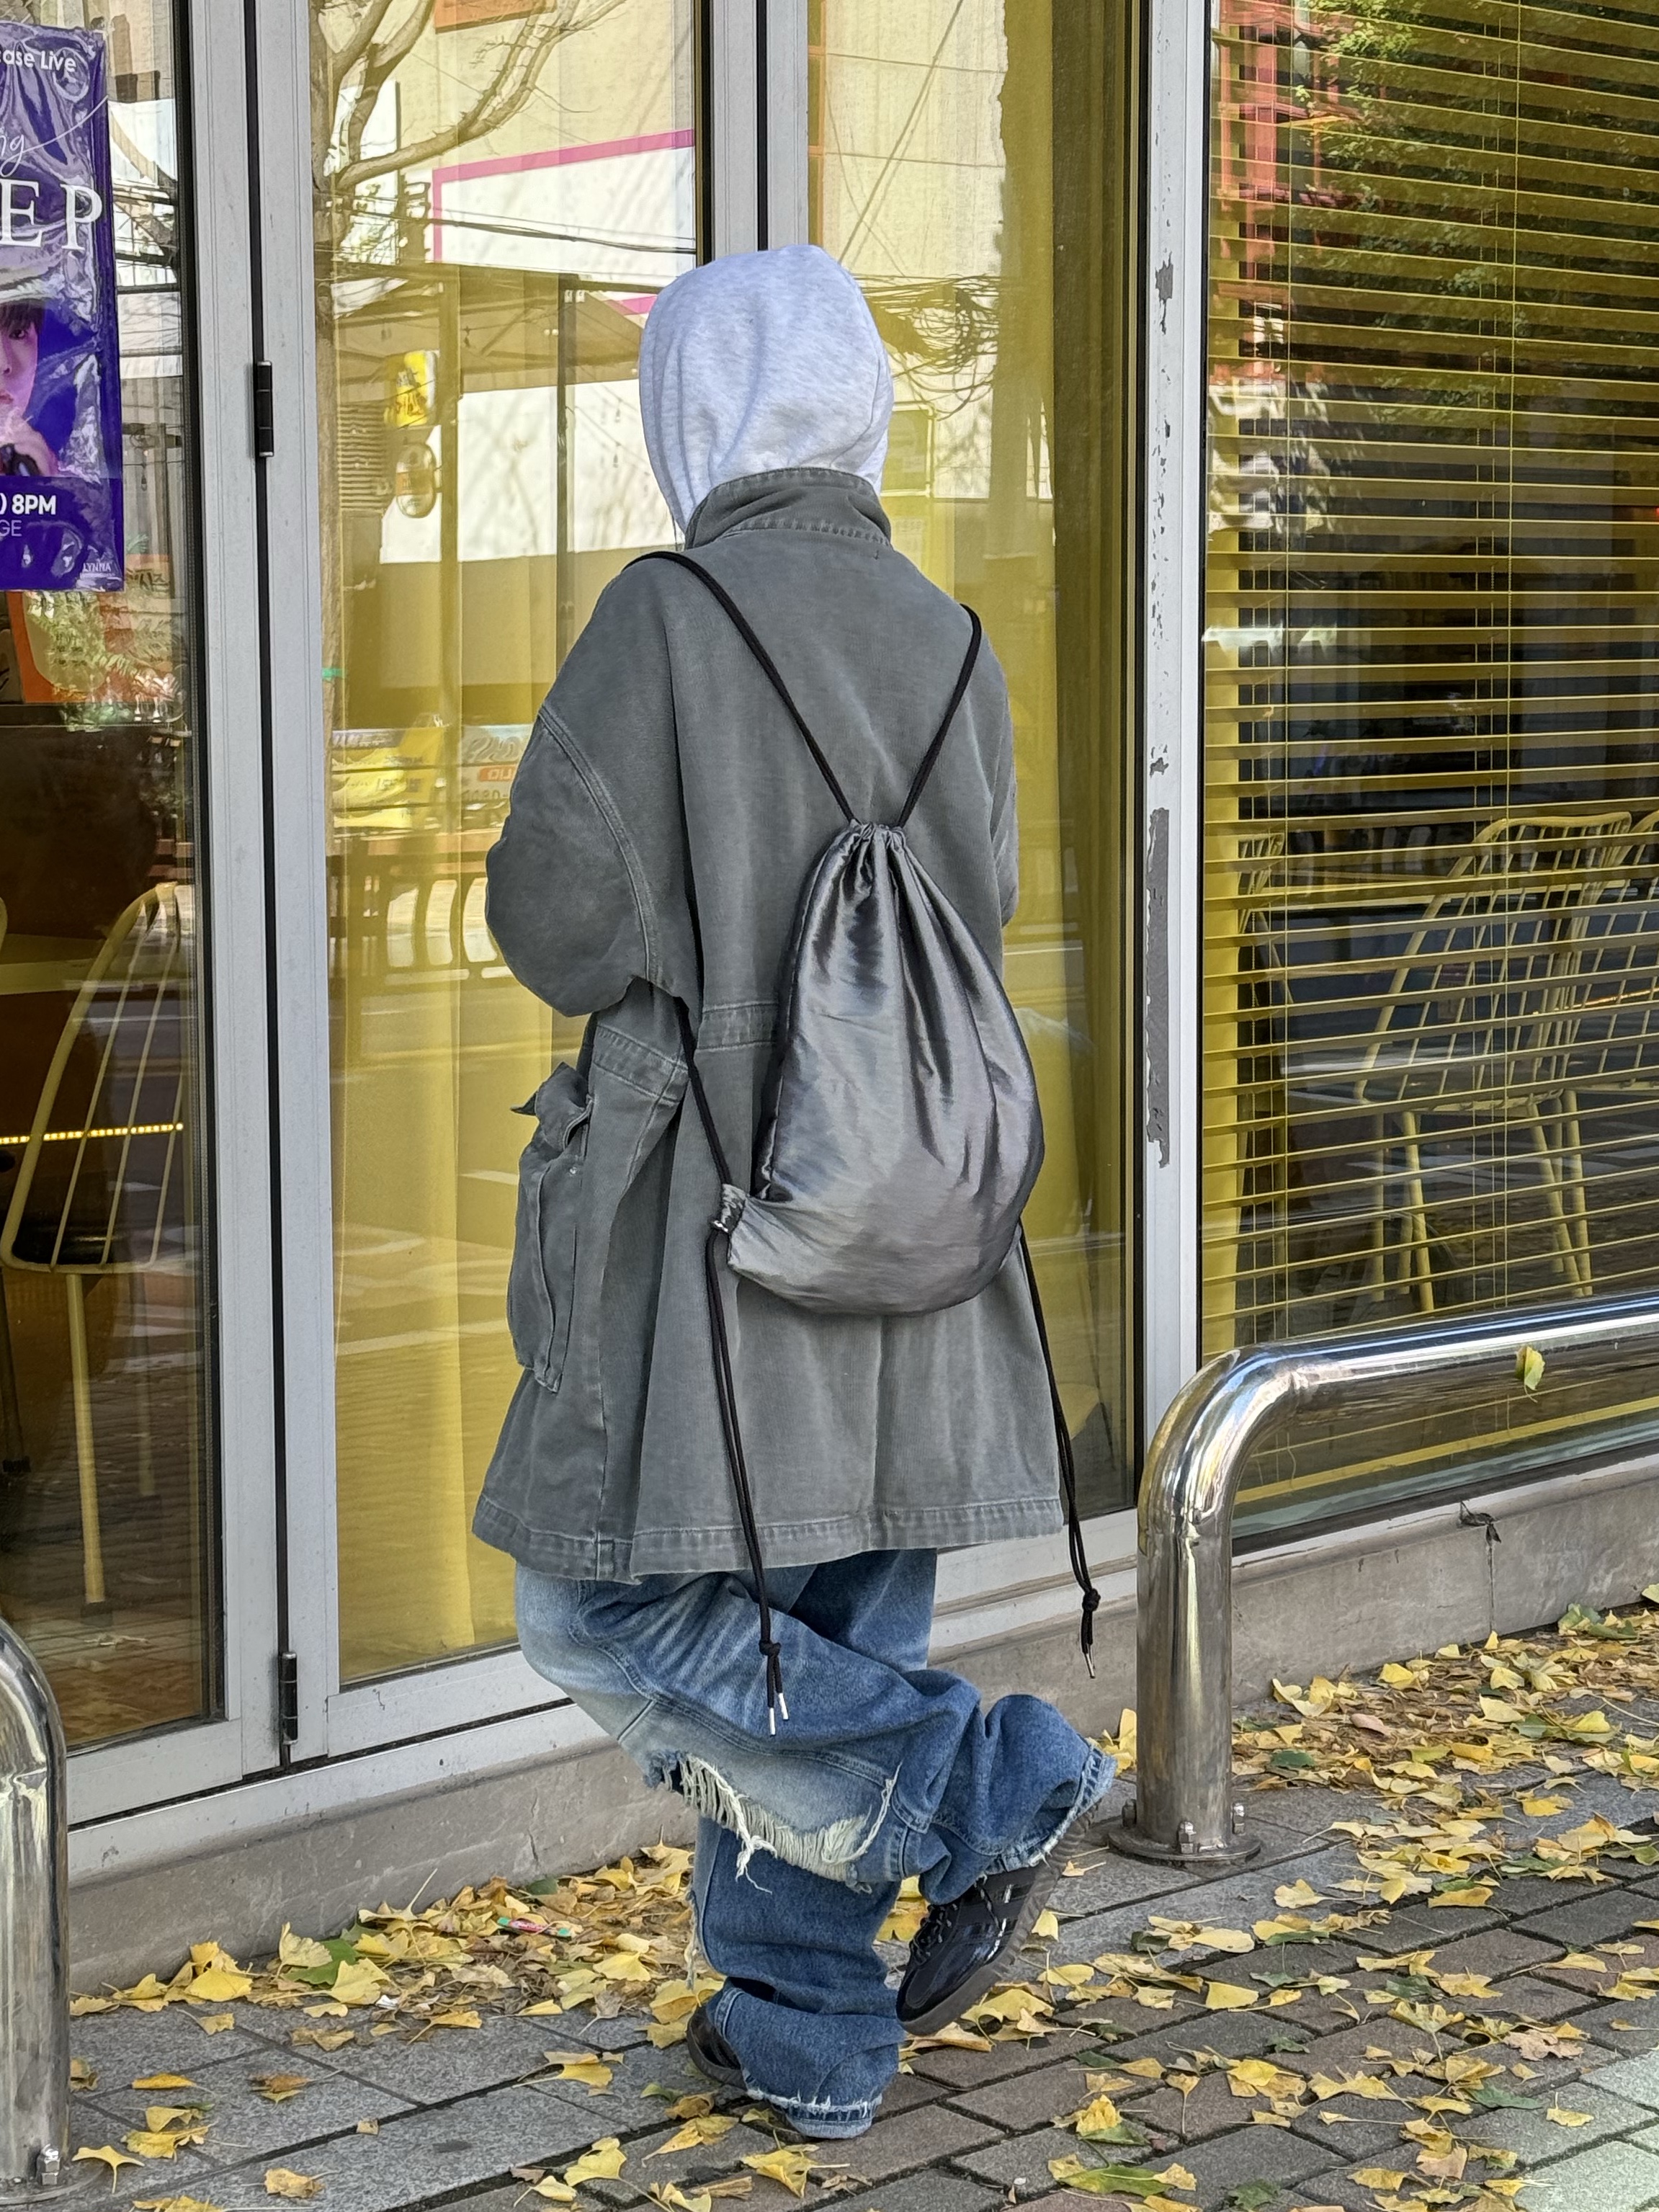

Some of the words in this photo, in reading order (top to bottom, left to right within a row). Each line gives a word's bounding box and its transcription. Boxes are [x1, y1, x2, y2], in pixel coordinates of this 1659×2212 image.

[0, 49, 35, 68] ase
[40, 50, 77, 73] Live
[12, 494, 56, 515] 8PM
